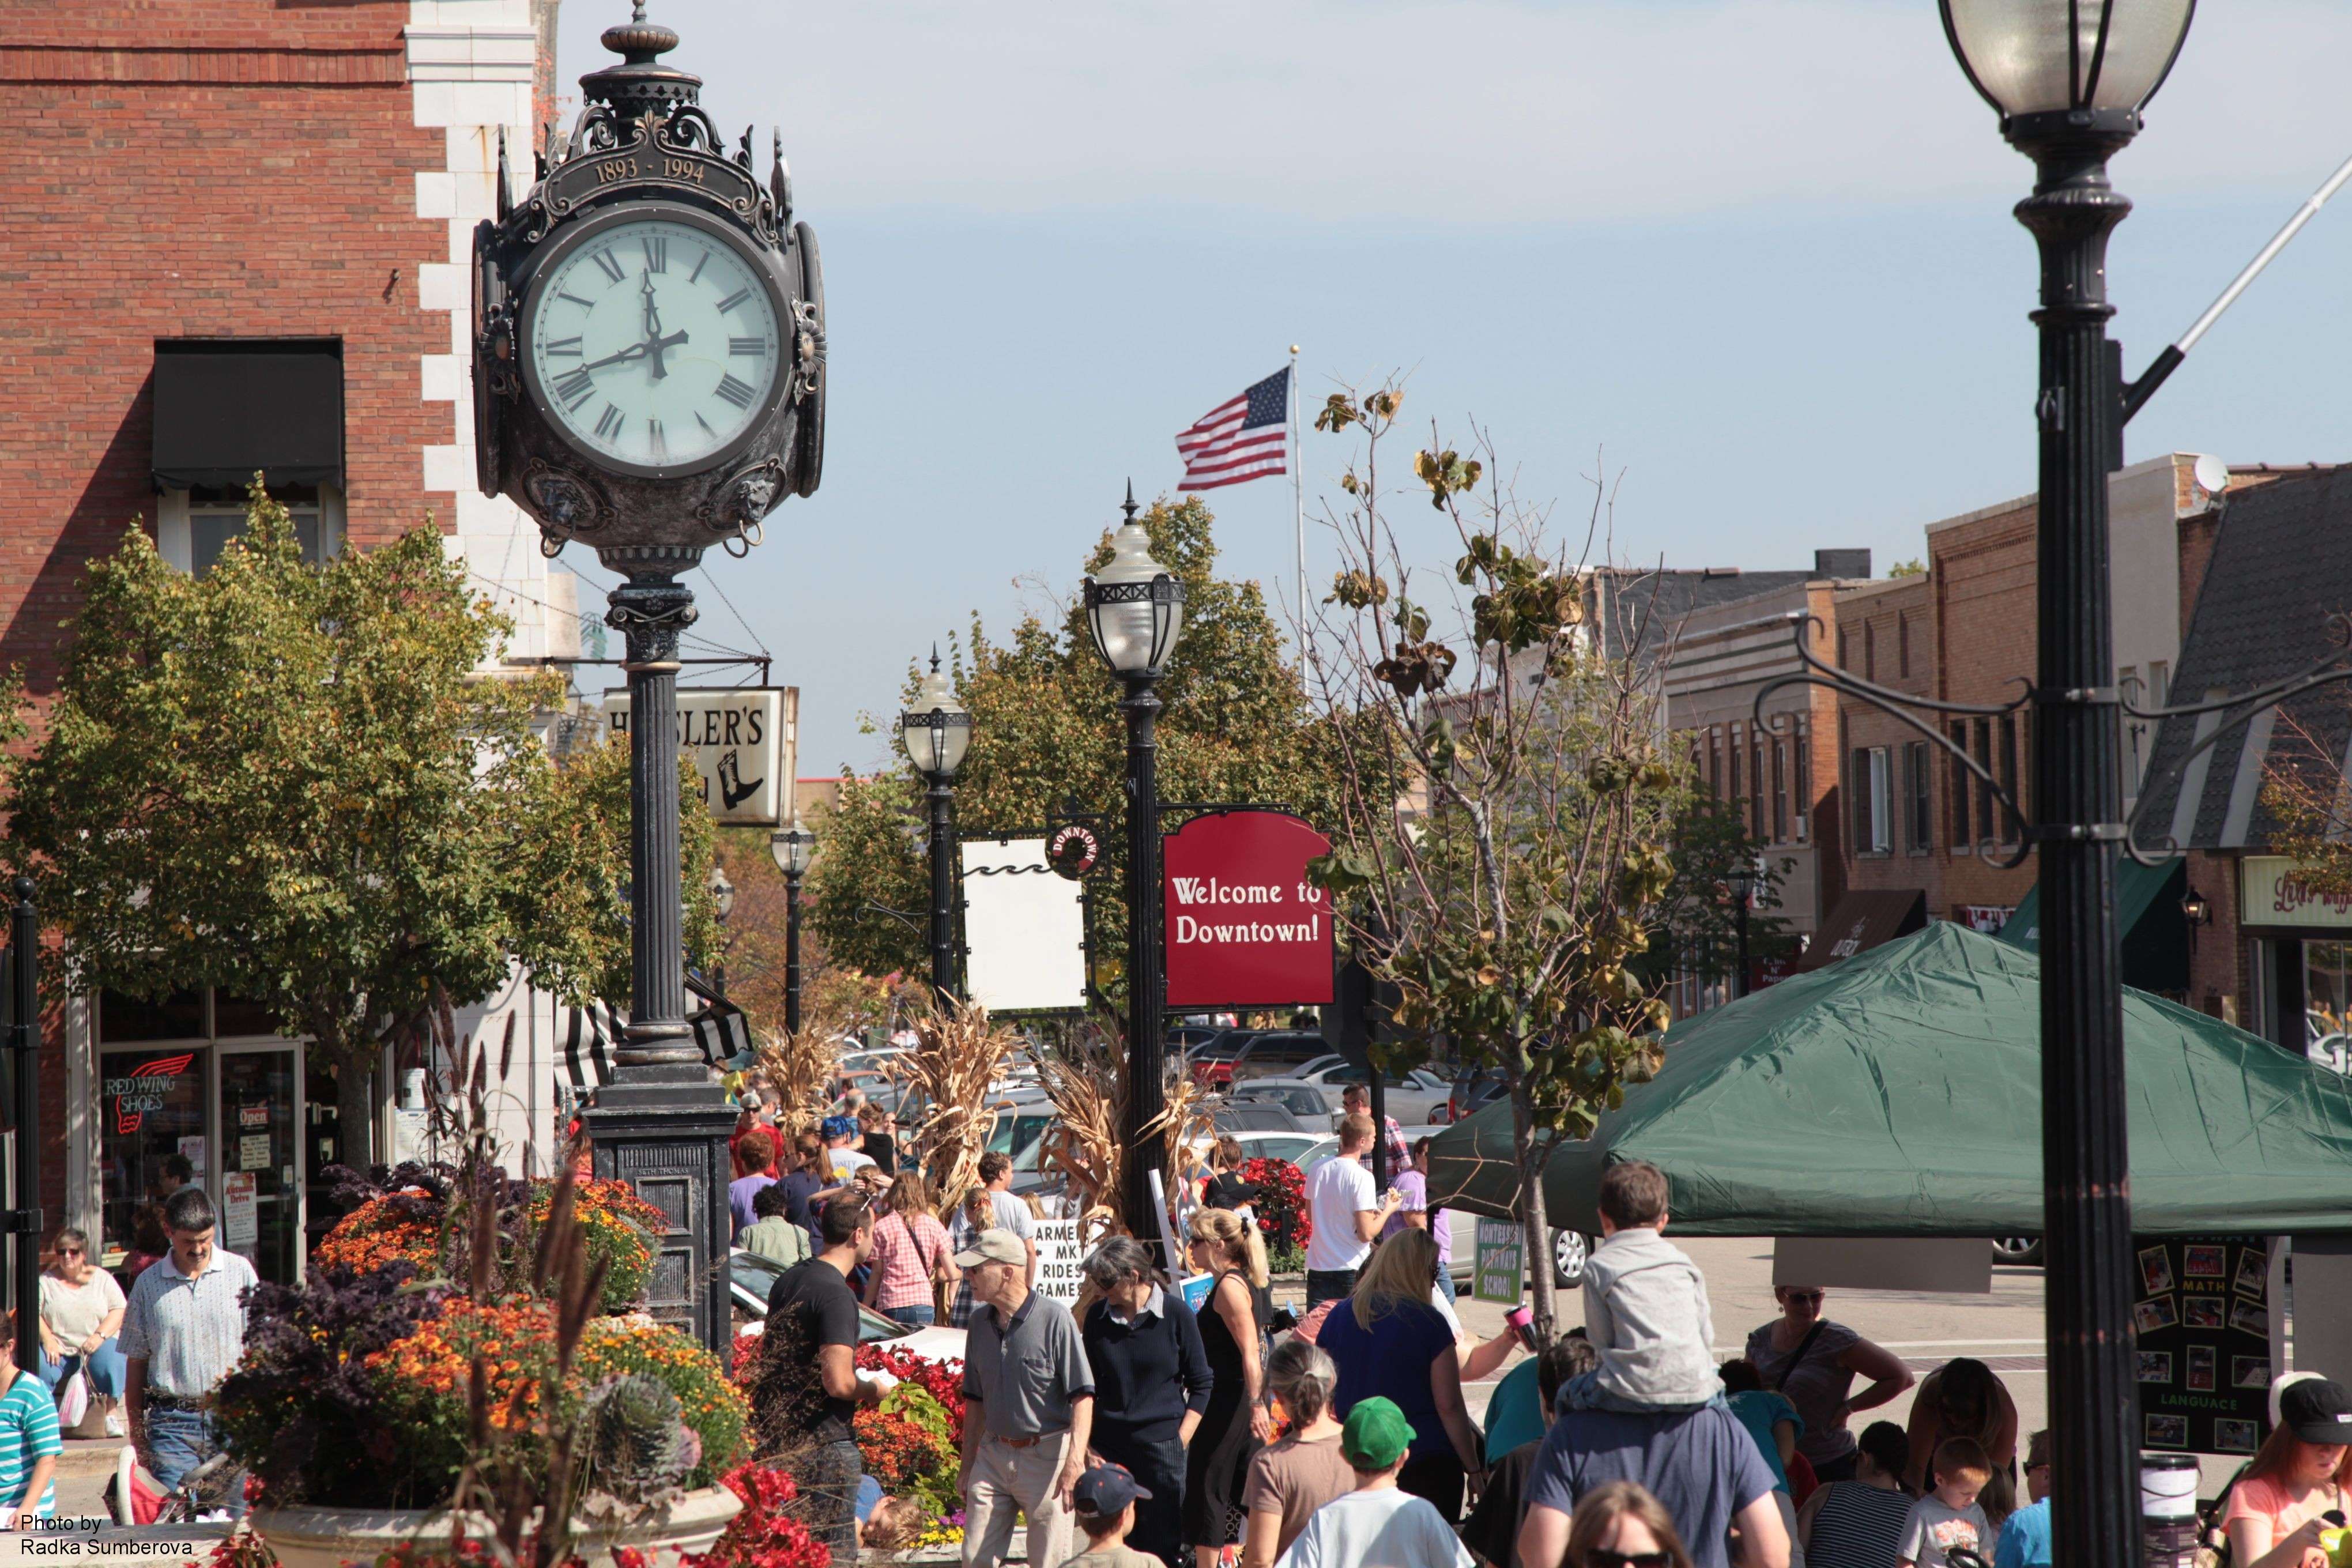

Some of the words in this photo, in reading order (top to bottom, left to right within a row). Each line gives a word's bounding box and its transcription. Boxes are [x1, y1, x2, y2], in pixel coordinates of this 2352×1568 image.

[596, 158, 638, 183] 1893
[663, 158, 704, 184] 1994
[1053, 827, 1097, 862] DOWNTOWN
[1172, 877, 1283, 904] Welcome
[1297, 882, 1321, 903] to
[1176, 914, 1318, 943] Downtown!
[105, 1078, 135, 1095] RED
[135, 1076, 176, 1092] WING
[121, 1094, 163, 1112] SHOES
[239, 1111, 266, 1125] Open
[231, 1194, 250, 1204] Drive
[1043, 1264, 1083, 1279] RIDES
[1483, 1274, 1510, 1298] SCHOOL
[2183, 1280, 2226, 1292] MATH
